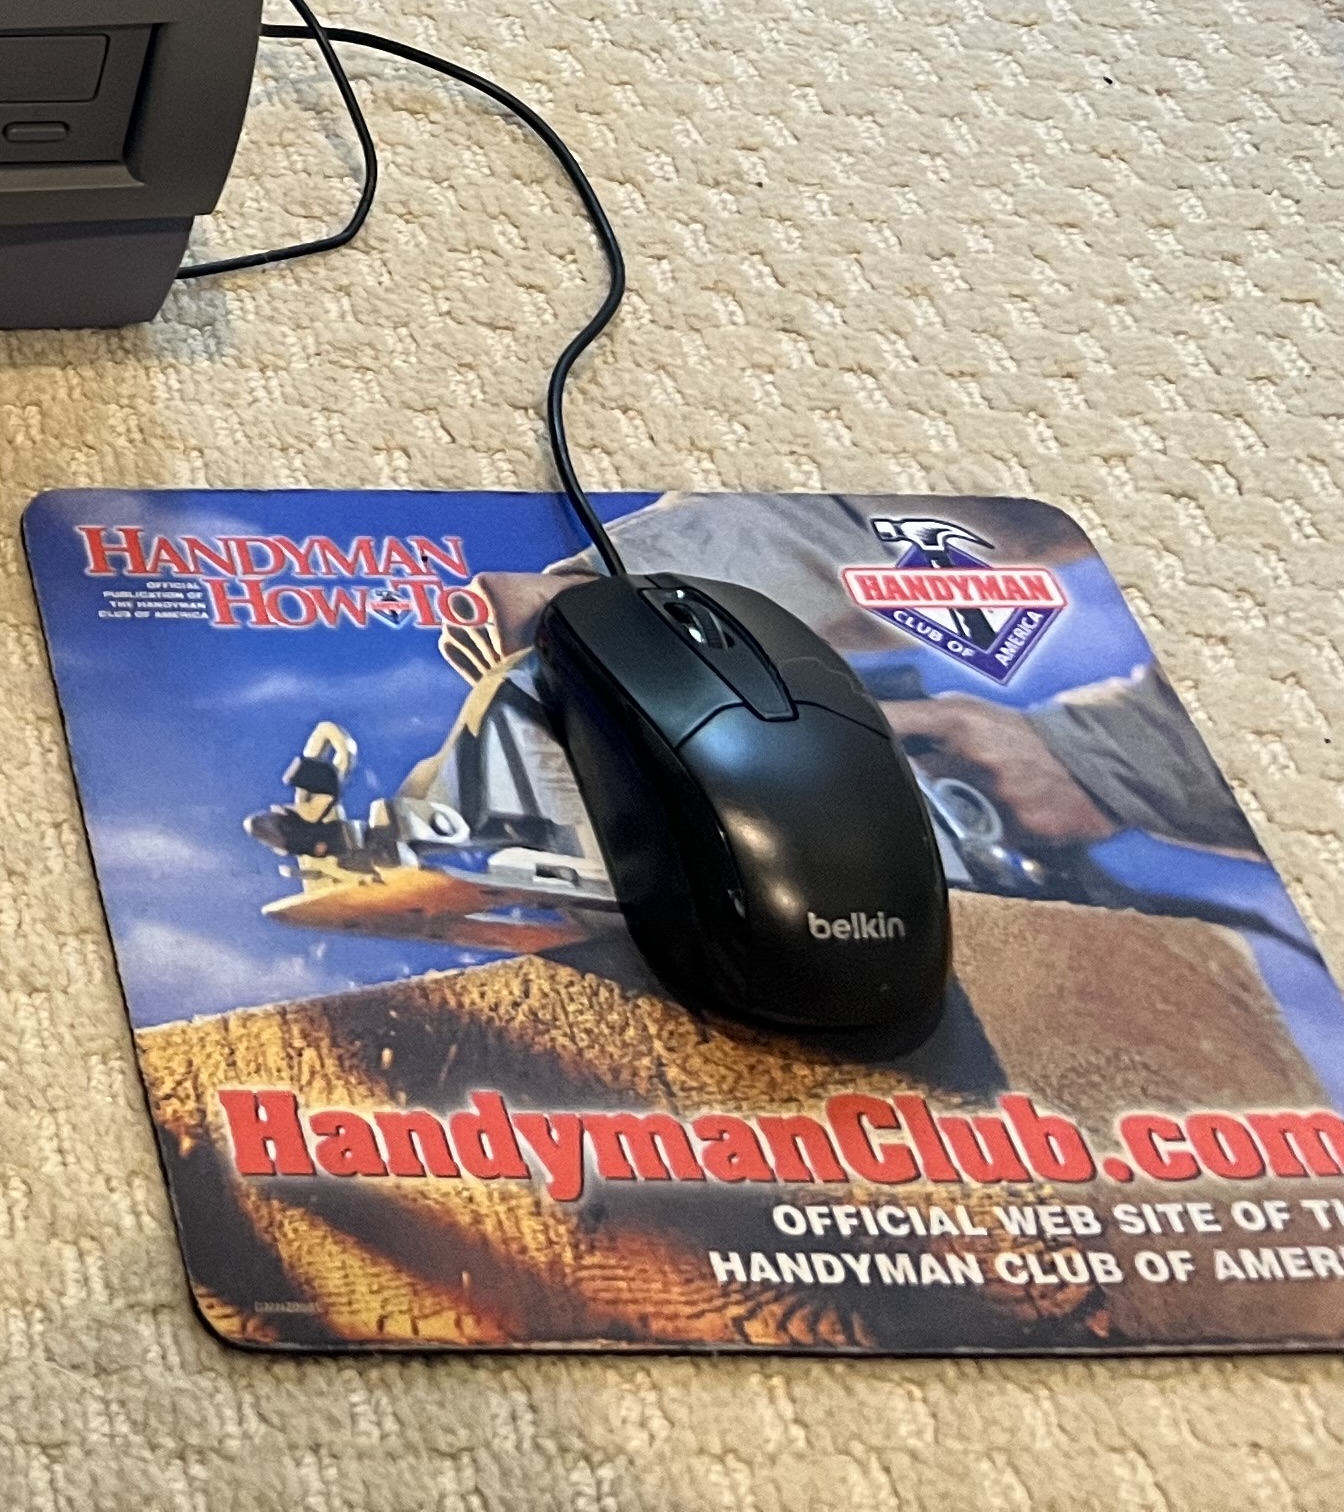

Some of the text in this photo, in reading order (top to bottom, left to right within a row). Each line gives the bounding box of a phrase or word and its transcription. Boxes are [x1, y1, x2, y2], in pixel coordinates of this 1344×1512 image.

[77, 525, 471, 577] HANDYMAN
[204, 577, 492, 628] HOW TO
[853, 573, 1054, 602] HANDYMAN
[892, 609, 1045, 669] CLUB OF AMERICA
[807, 911, 906, 940] belkin
[219, 1090, 1344, 1201] HandymanClub.com
[772, 1203, 988, 1237] OFFICIAL
[994, 1204, 1103, 1236] WEB
[1113, 1202, 1222, 1235] SITE
[1230, 1199, 1291, 1232] OF
[708, 1245, 1344, 1287] HANDYMAN CLUB OF AMER
